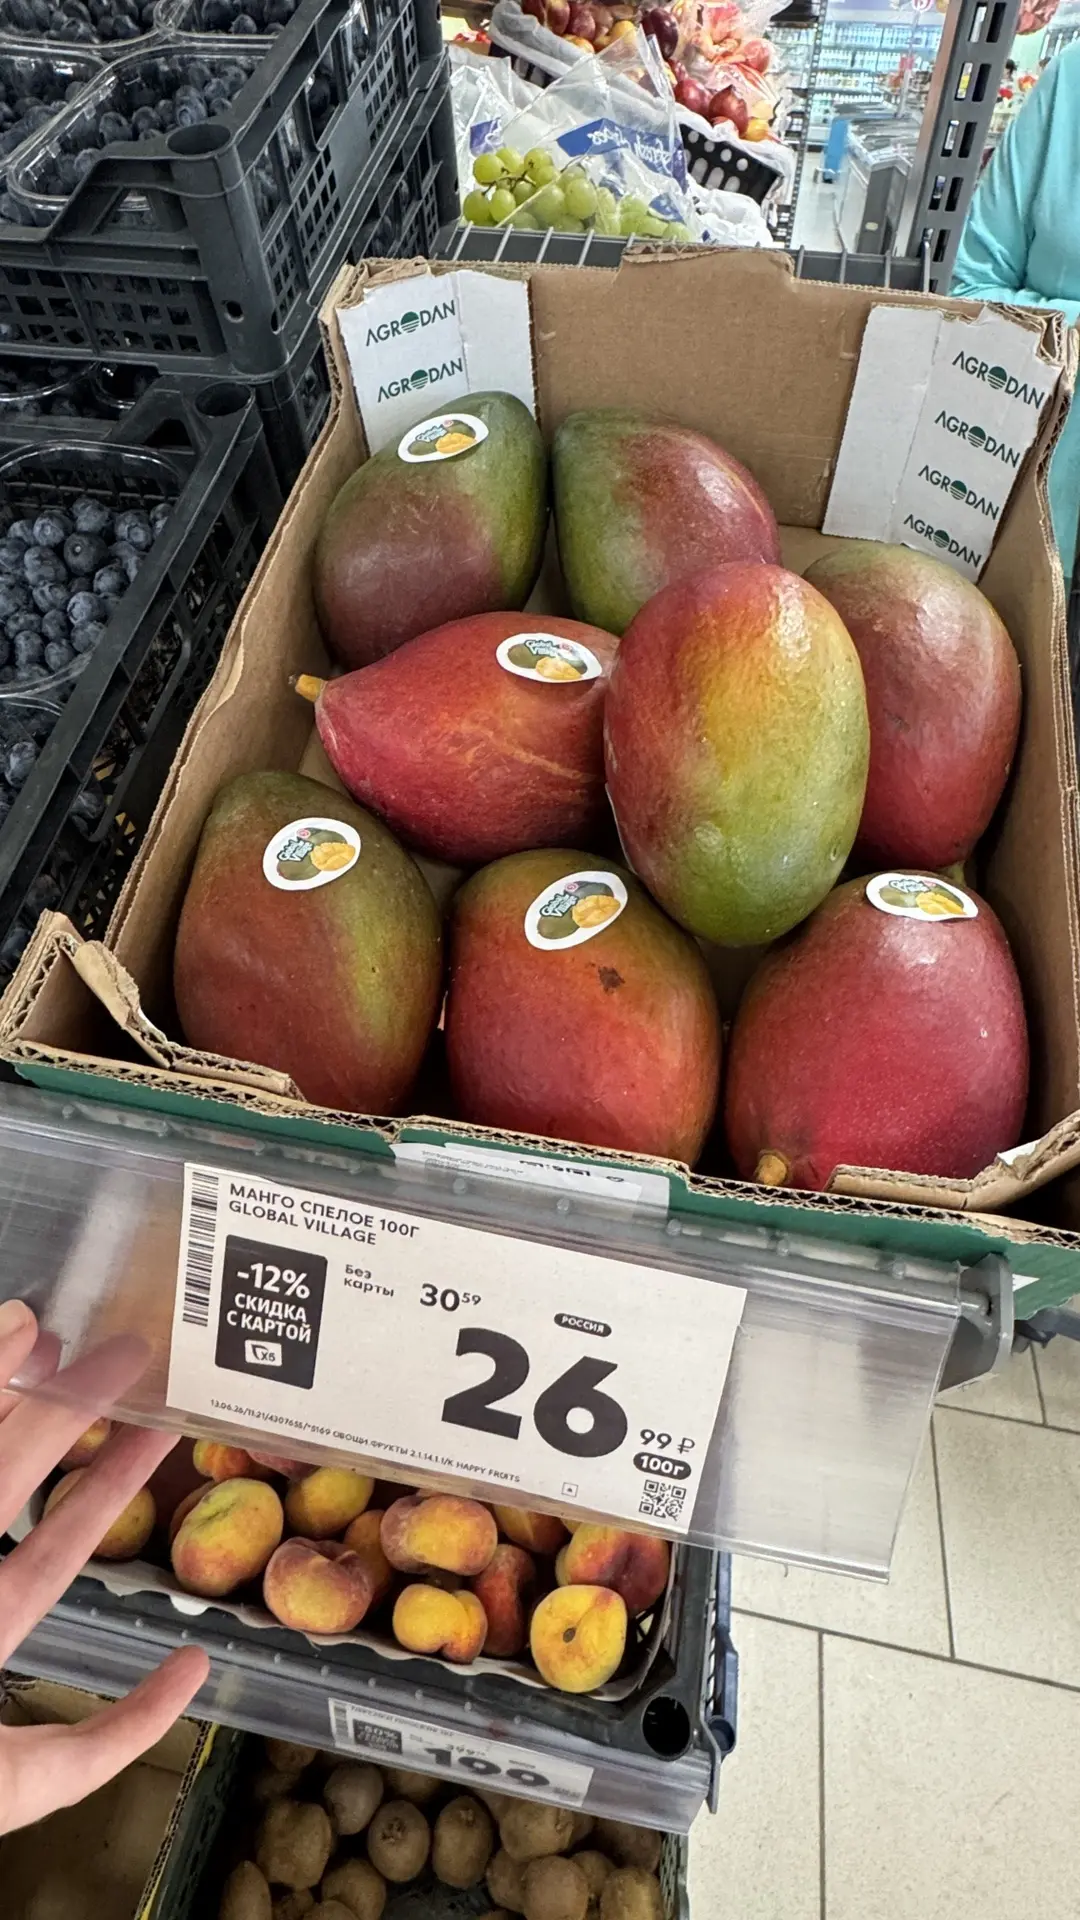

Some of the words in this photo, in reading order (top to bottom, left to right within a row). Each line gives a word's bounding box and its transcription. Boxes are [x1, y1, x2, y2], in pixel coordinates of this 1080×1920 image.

[366, 300, 456, 347] AGRODAN
[377, 357, 463, 403] AGRODAN
[951, 351, 1045, 409] AGRODAN
[934, 410, 1021, 468] AGRODAN
[918, 464, 1000, 520] AGRODAN
[903, 513, 982, 568] AGRODAN
[228, 1201, 299, 1227] GLOBAL
[304, 1219, 377, 1246] VILLAGE
[229, 1183, 295, 1209] МАНГО
[300, 1200, 374, 1228] СПЕЛОЕ
[237, 1262, 311, 1299] -12%
[343, 1277, 395, 1297] карты
[345, 1264, 372, 1279] Без
[226, 1309, 238, 1327] С
[241, 1312, 312, 1344] КАРТОЙ
[234, 1292, 307, 1323] СКИДКА
[561, 1315, 605, 1333] РОССИЯ
[441, 1327, 628, 1458] 26
[640, 1428, 672, 1449] 99
[456, 1461, 486, 1475] HAPPY
